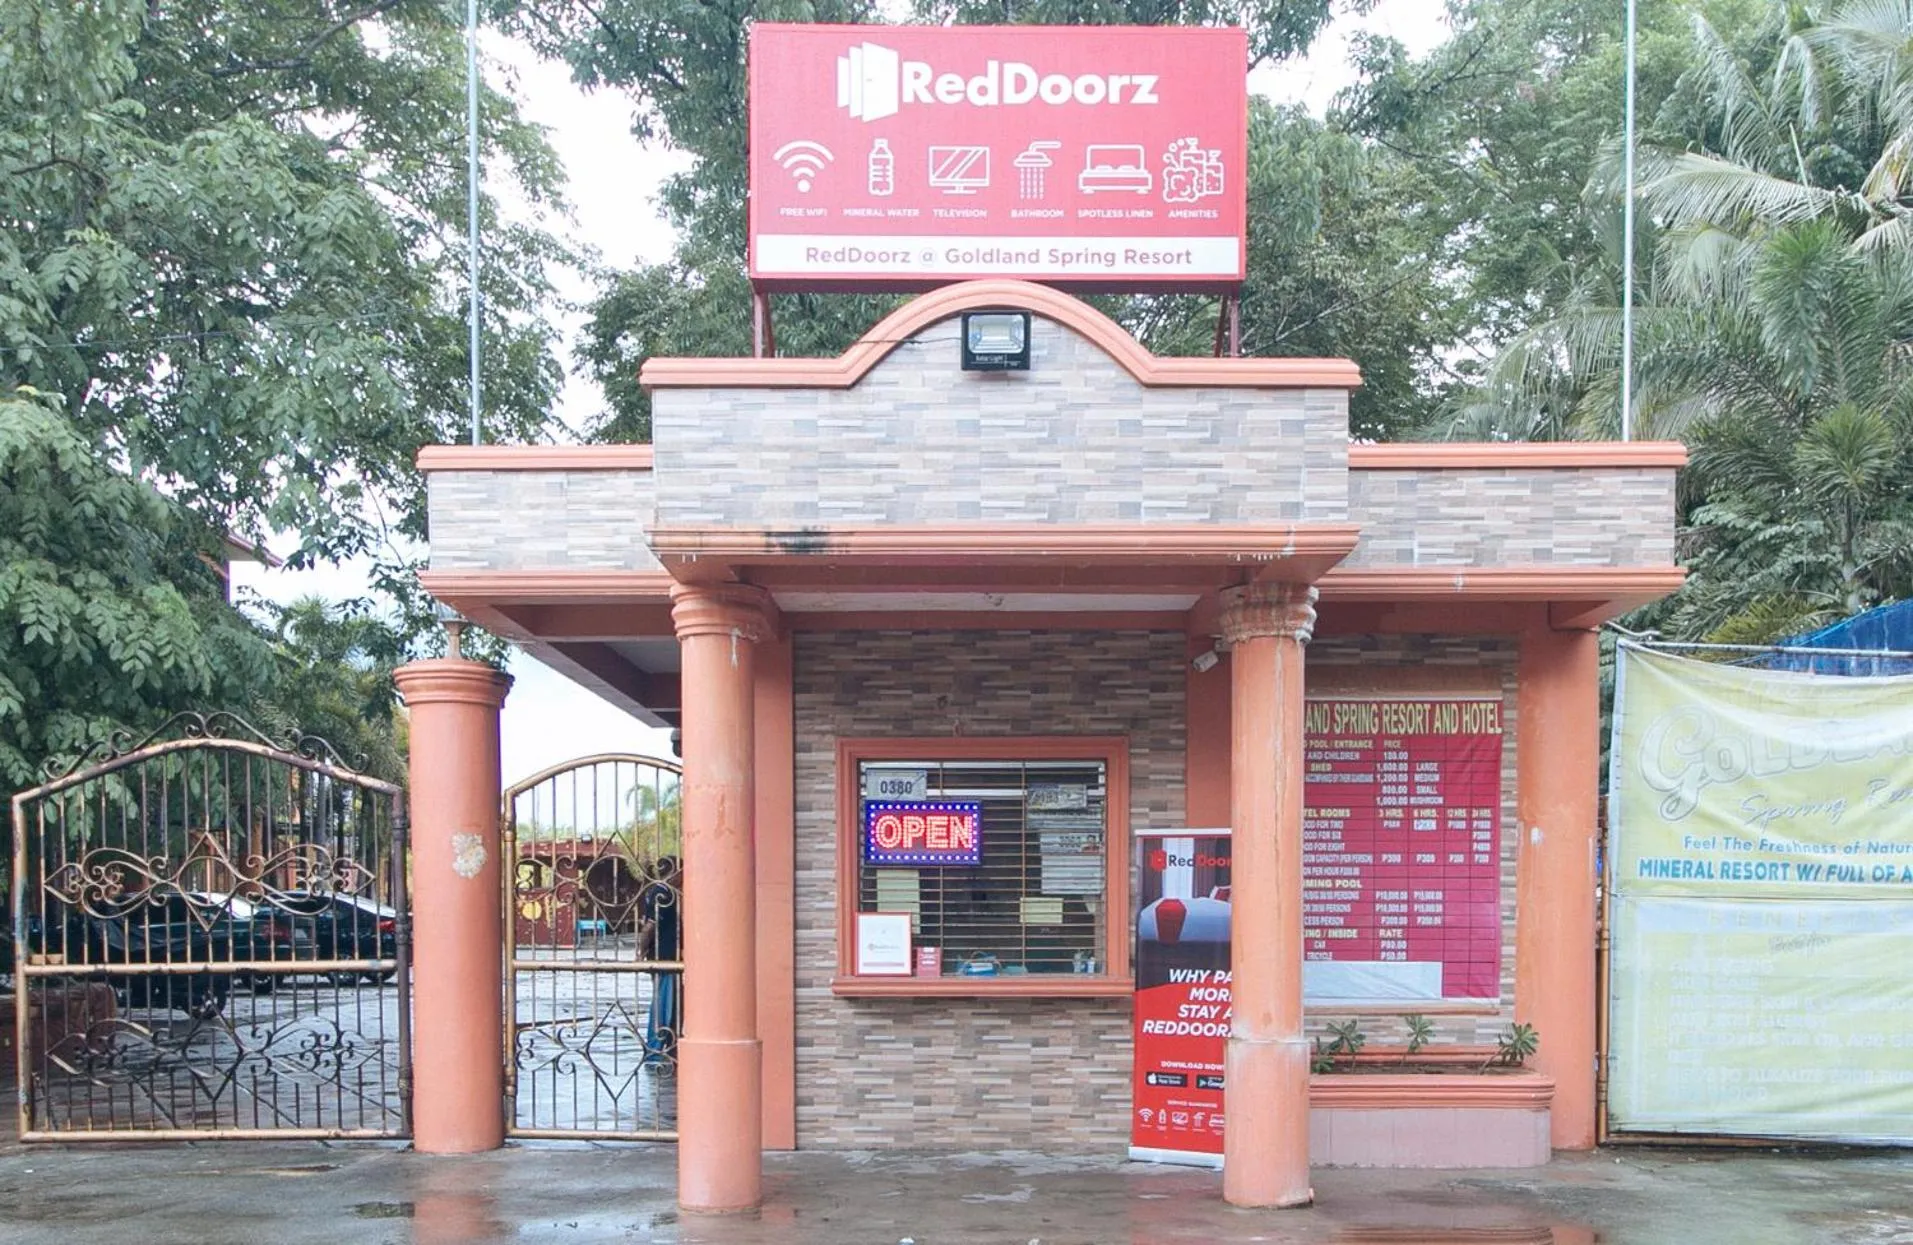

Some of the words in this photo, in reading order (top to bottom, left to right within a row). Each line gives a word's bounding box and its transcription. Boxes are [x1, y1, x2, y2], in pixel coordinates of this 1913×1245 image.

[903, 60, 1159, 105] RedDoorz
[780, 207, 805, 217] FREE
[806, 207, 827, 217] WIFI
[844, 208, 885, 217] MINERAL
[887, 208, 920, 217] WATER
[932, 208, 987, 218] TELEVISION
[1011, 208, 1064, 218] BATHROOM
[1077, 208, 1123, 218] SPOTLESS
[1126, 208, 1153, 218] LINEN
[1168, 208, 1218, 218] AMENITIES
[806, 247, 911, 263] RedDoorz
[945, 247, 1040, 264] Goldland
[1048, 248, 1116, 268] Spring
[1124, 248, 1192, 265] Resort
[1334, 703, 1379, 734] SPRING
[1383, 703, 1431, 734] RESORT
[1433, 703, 1459, 734] AND
[1463, 703, 1502, 734] HOTEL
[880, 780, 913, 795] 0380
[876, 815, 973, 848] OPEN
[1684, 836, 1716, 850] Feel
[1723, 837, 1752, 851] The
[1758, 838, 1837, 855] Freshness
[1843, 840, 1861, 855] of
[1639, 859, 1714, 880] MINERAL
[1720, 861, 1790, 881] RESORT
[1796, 863, 1820, 882] W/
[1825, 864, 1865, 883] FULL
[1872, 865, 1896, 883] OF
[1335, 880, 1362, 888] POOL
[1380, 929, 1403, 938] RATE
[1169, 968, 1211, 984] WHY
[1189, 988, 1232, 1002] MOR
[1178, 1004, 1220, 1019] STAY
[1142, 1020, 1232, 1038] REDDOOR
[1161, 1060, 1204, 1070] DOWNLOAD
